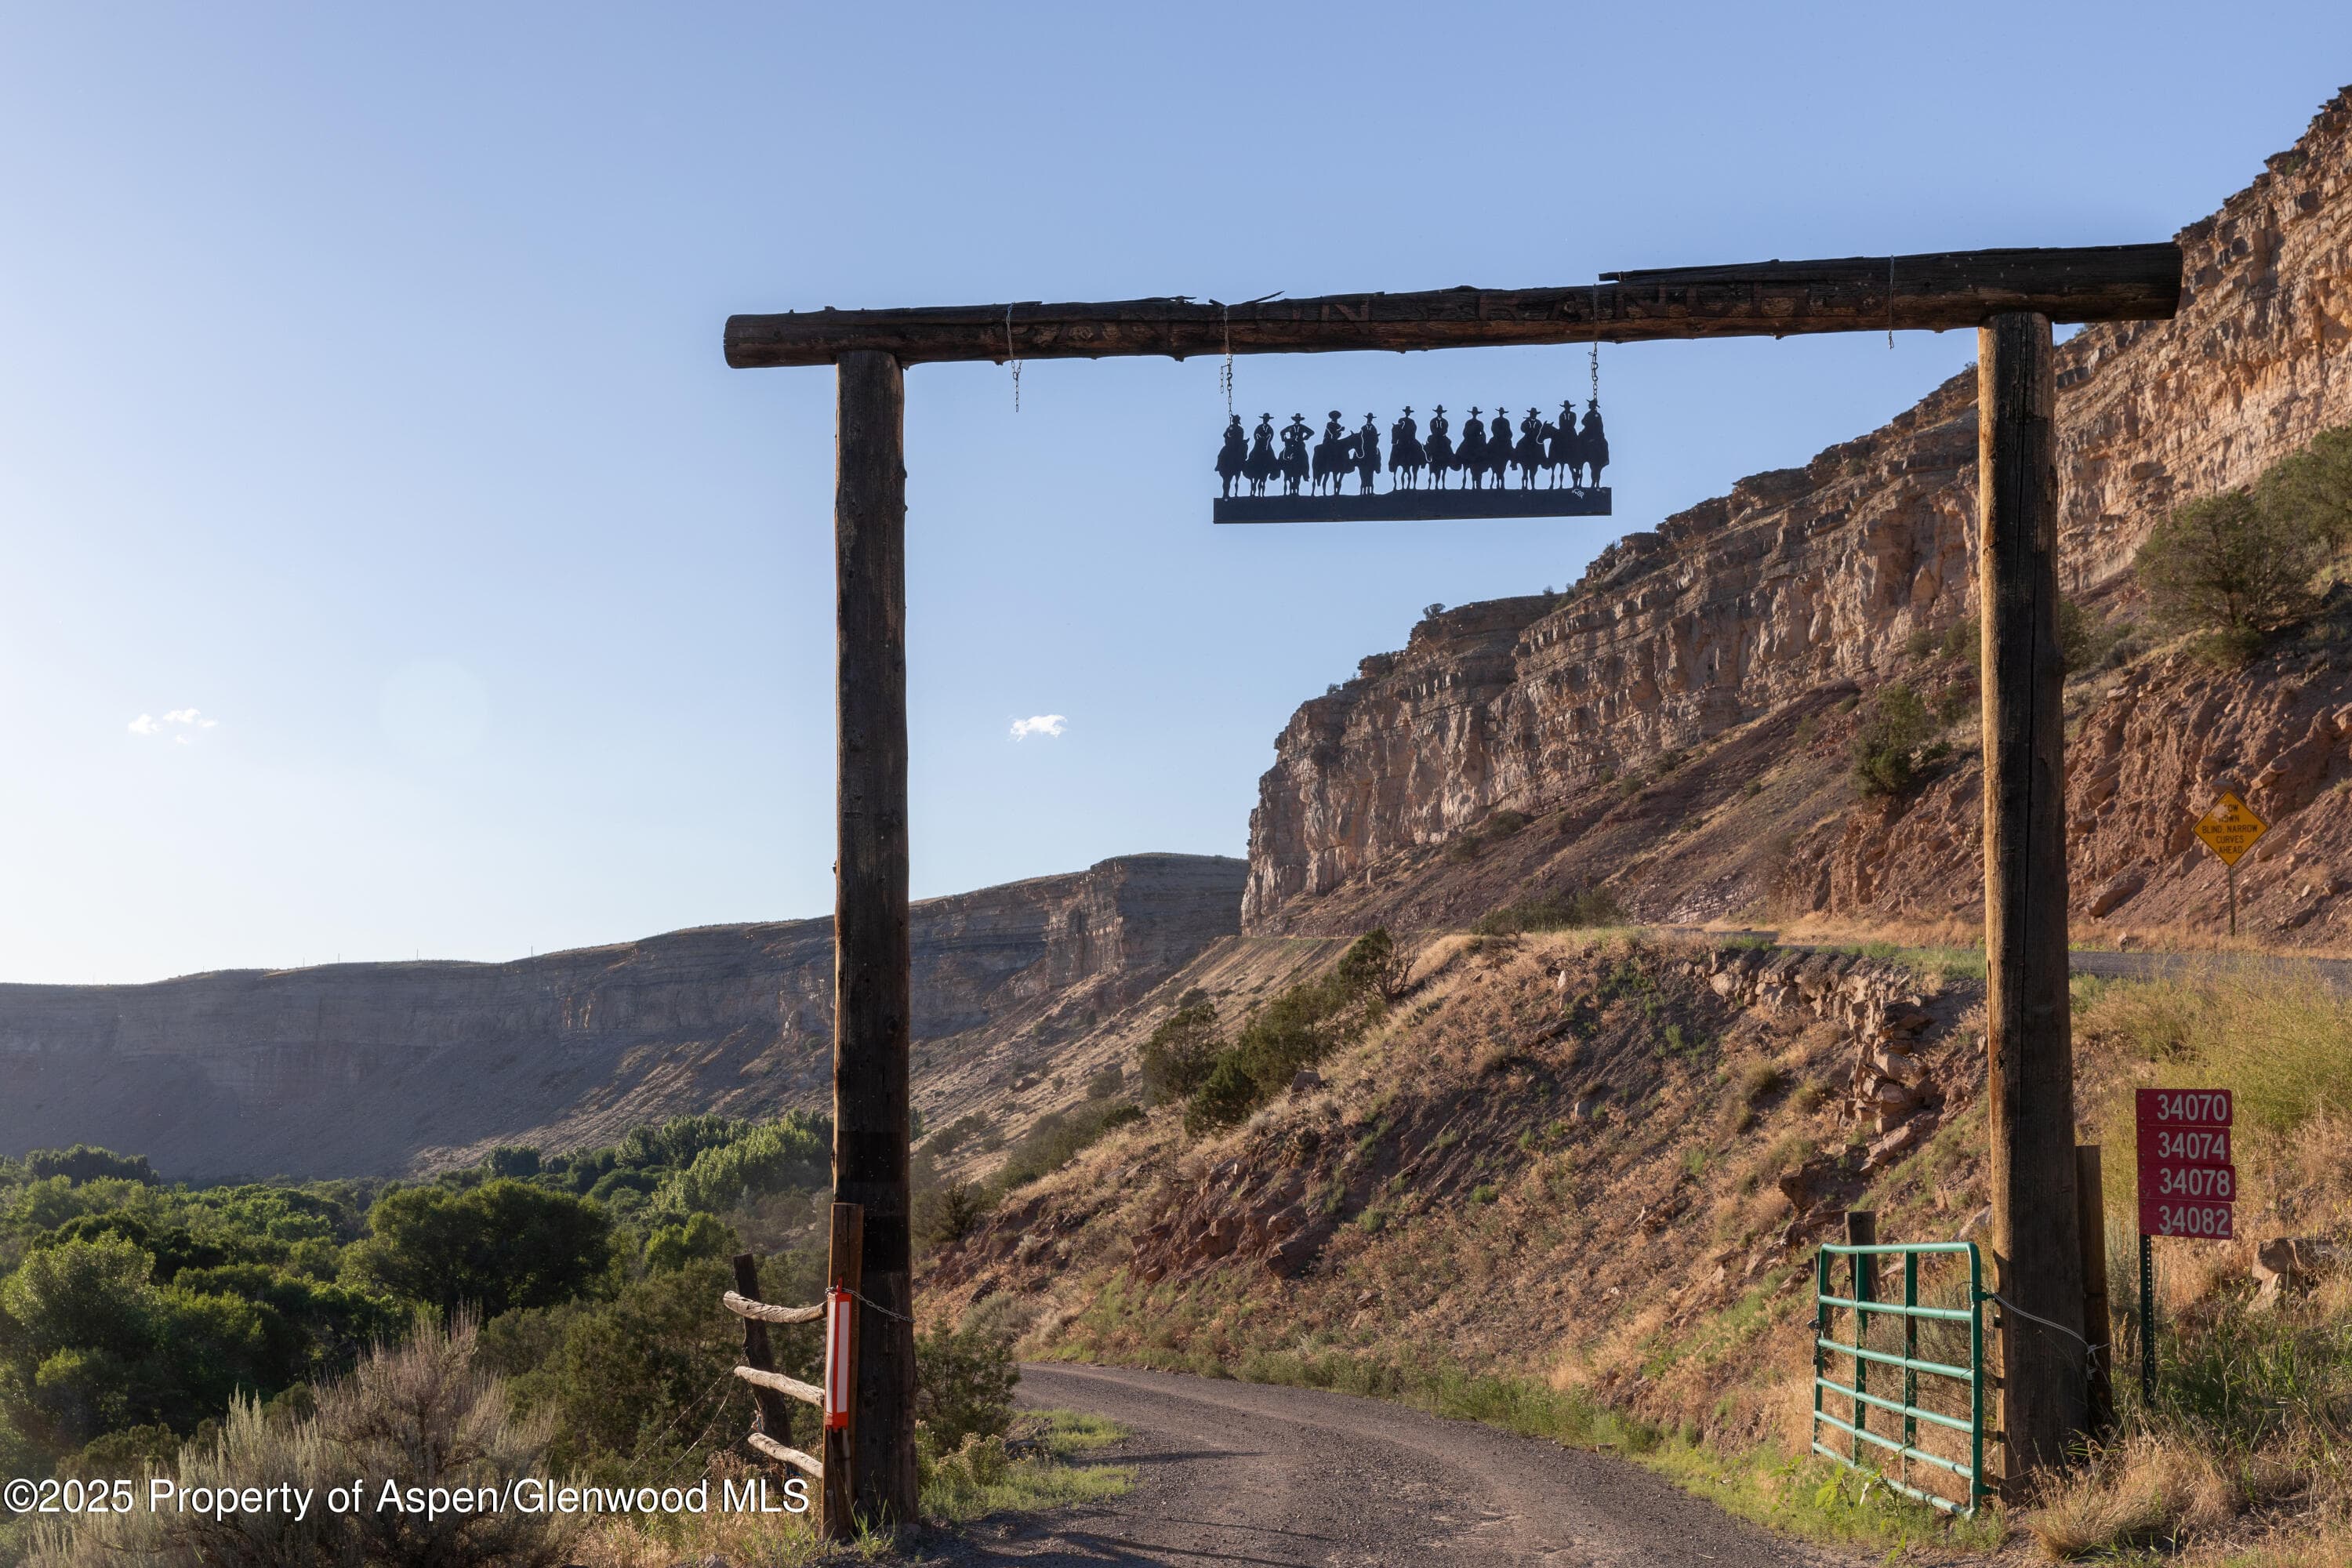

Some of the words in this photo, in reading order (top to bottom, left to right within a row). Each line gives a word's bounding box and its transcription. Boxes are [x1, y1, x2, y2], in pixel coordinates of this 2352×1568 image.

[2216, 835, 2245, 844] CURVES
[2227, 824, 2258, 833] NARROW
[2219, 845, 2243, 854] AHEAD
[2157, 1094, 2227, 1121] 34070
[2158, 1131, 2227, 1160] 34074
[2158, 1167, 2230, 1196] 34078
[2158, 1205, 2230, 1236] 34082
